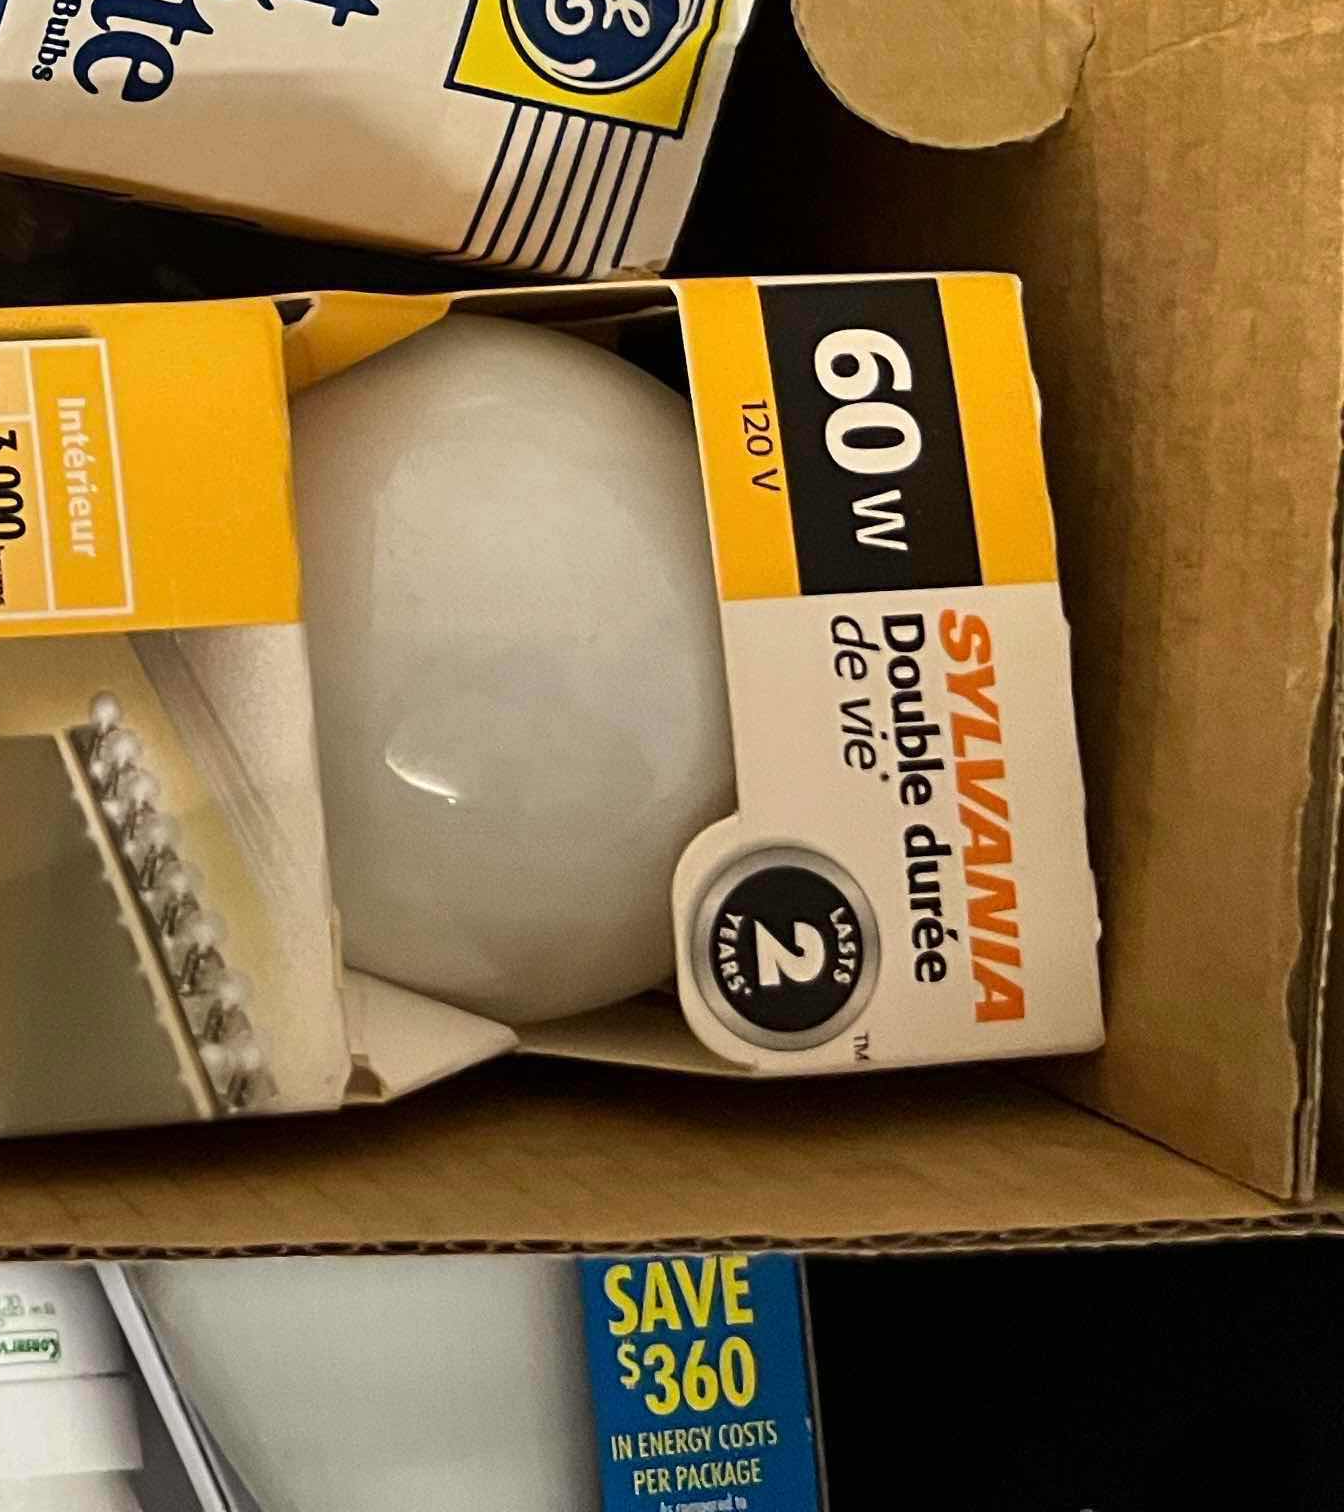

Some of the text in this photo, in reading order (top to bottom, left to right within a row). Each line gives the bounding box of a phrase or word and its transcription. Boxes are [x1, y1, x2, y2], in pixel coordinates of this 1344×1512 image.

[31, 2, 71, 83] Bulbs
[812, 328, 923, 474] 60
[56, 395, 98, 559] Intérieur
[740, 400, 783, 493] 120 V
[830, 614, 879, 681] de
[881, 613, 948, 985] Double durée
[938, 609, 1026, 1024] SYLVANIA
[754, 919, 825, 991] 2
[829, 905, 859, 986] LASTS
[604, 1256, 753, 1335] SAVE
[617, 1337, 755, 1414] $360
[611, 1420, 778, 1461] IN ENERGY COSTS
[632, 1458, 762, 1495] PER PACKAGE
